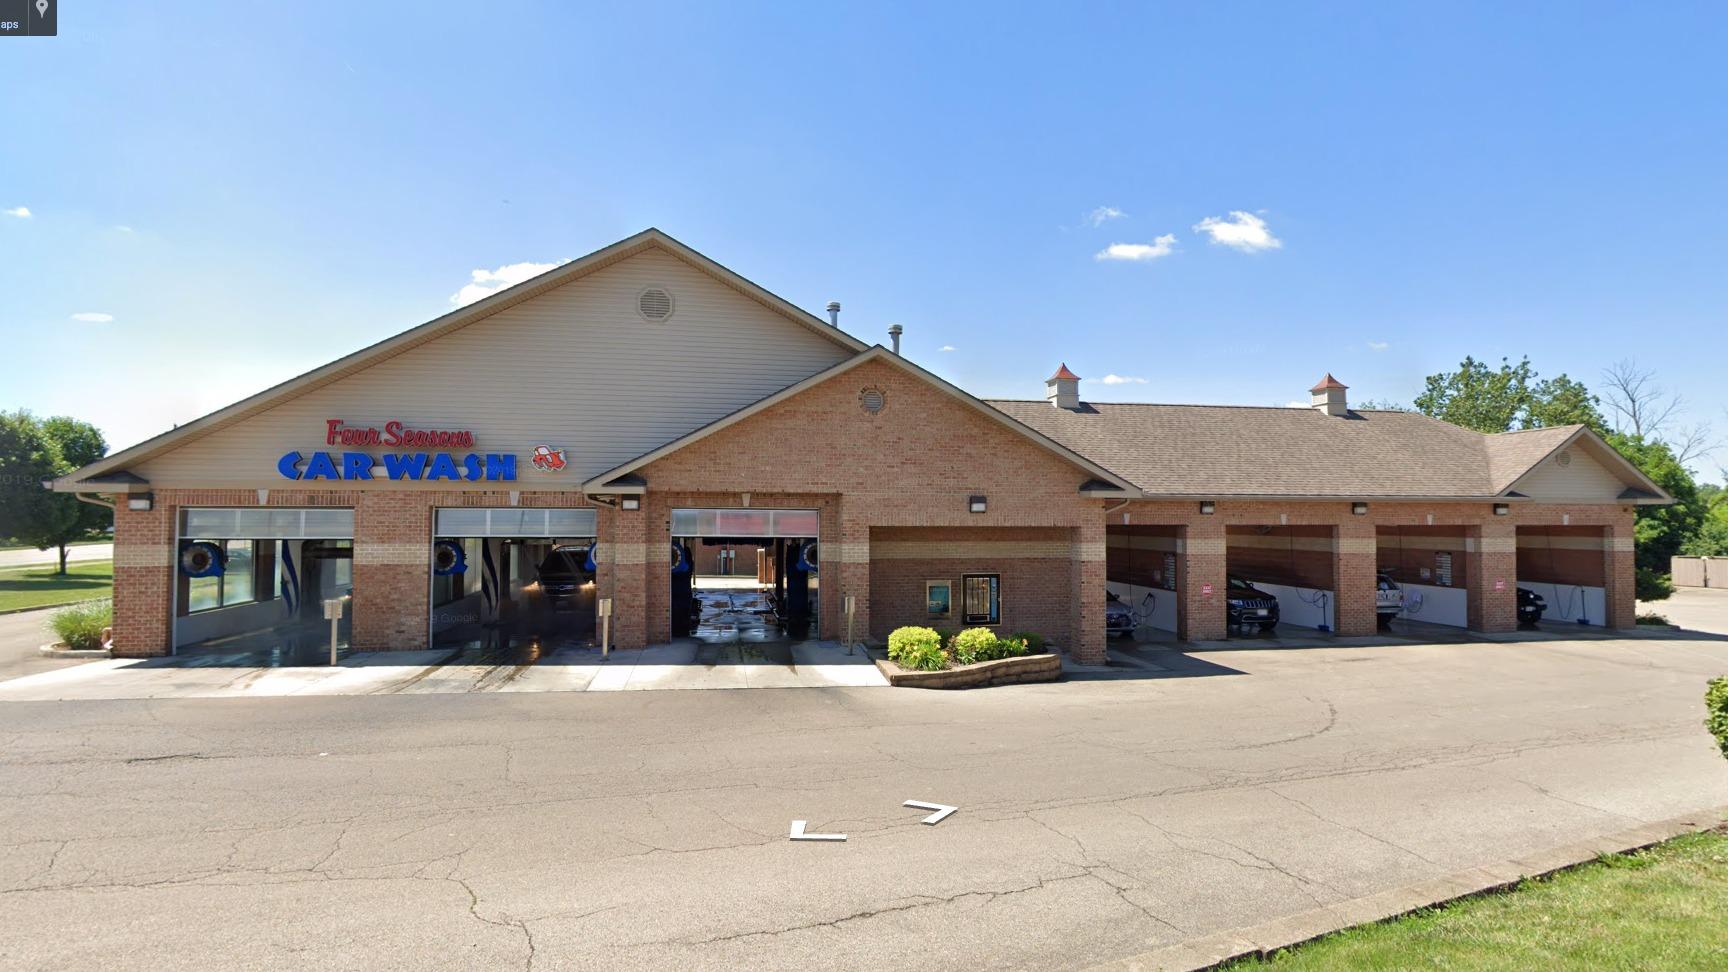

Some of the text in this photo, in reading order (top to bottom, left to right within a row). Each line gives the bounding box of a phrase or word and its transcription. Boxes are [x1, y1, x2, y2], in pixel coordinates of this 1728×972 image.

[326, 419, 474, 448] Four Seasons
[277, 451, 374, 481] CAR
[382, 453, 517, 481] WASH
